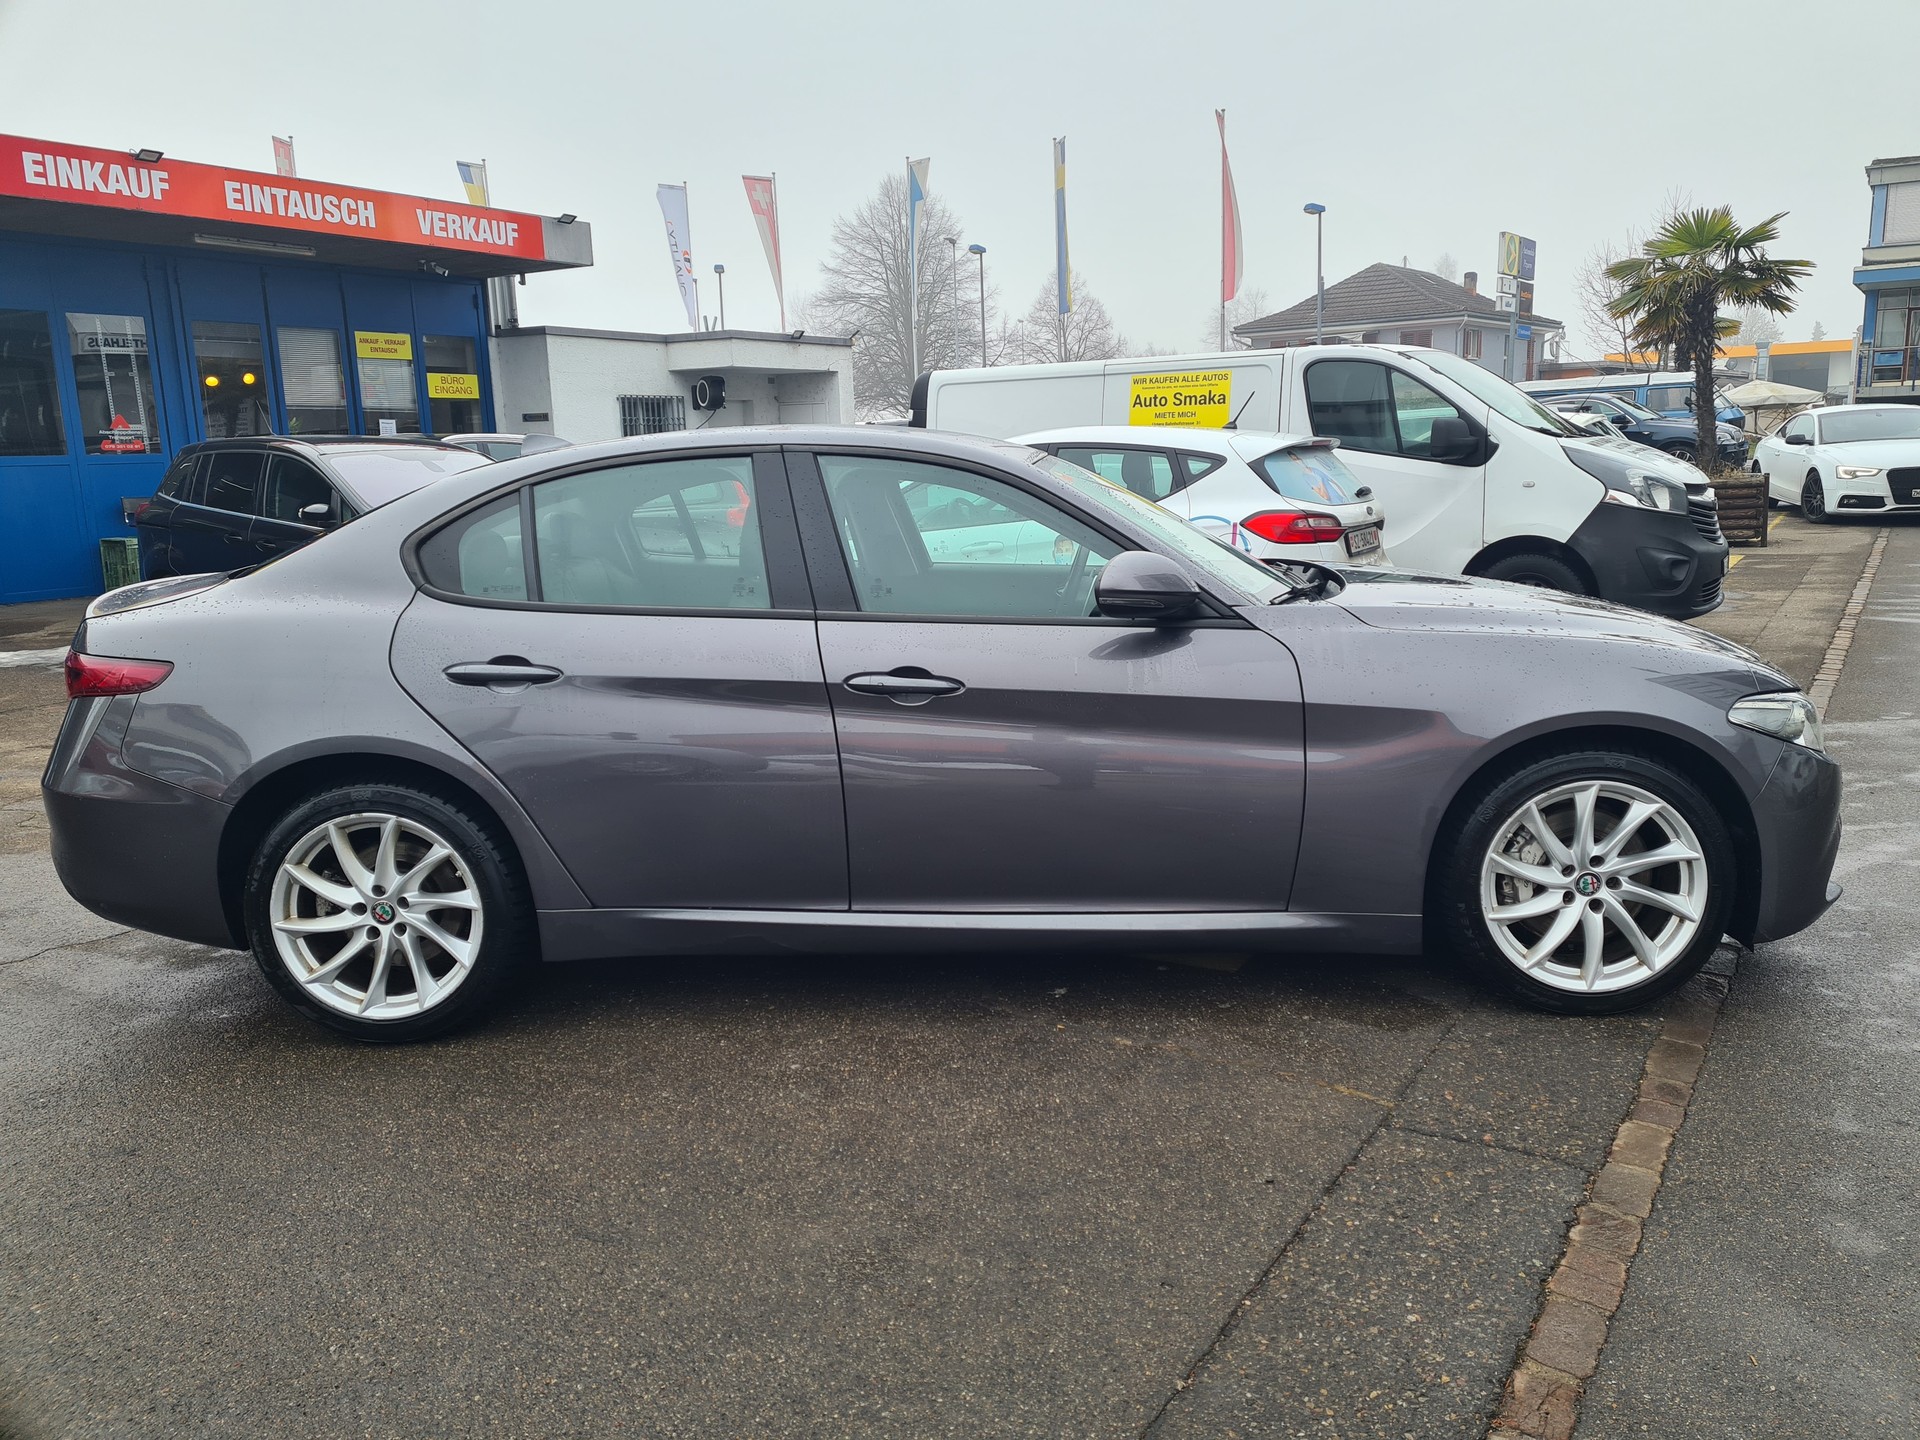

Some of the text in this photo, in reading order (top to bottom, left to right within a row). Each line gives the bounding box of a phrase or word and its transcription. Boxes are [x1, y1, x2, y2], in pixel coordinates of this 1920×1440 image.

[22, 151, 519, 247] EINKAUF EINTAUSCH VERKAUF
[383, 338, 406, 346] VERKAUF
[440, 375, 465, 385] BÜRO
[1149, 376, 1180, 384] KAUFEN
[1181, 374, 1201, 382] ALLE
[1202, 373, 1229, 381] AUTOS
[434, 385, 473, 394] EINGANG
[1132, 390, 1226, 408] Auto Smaka
[1154, 411, 1176, 419] MIETE
